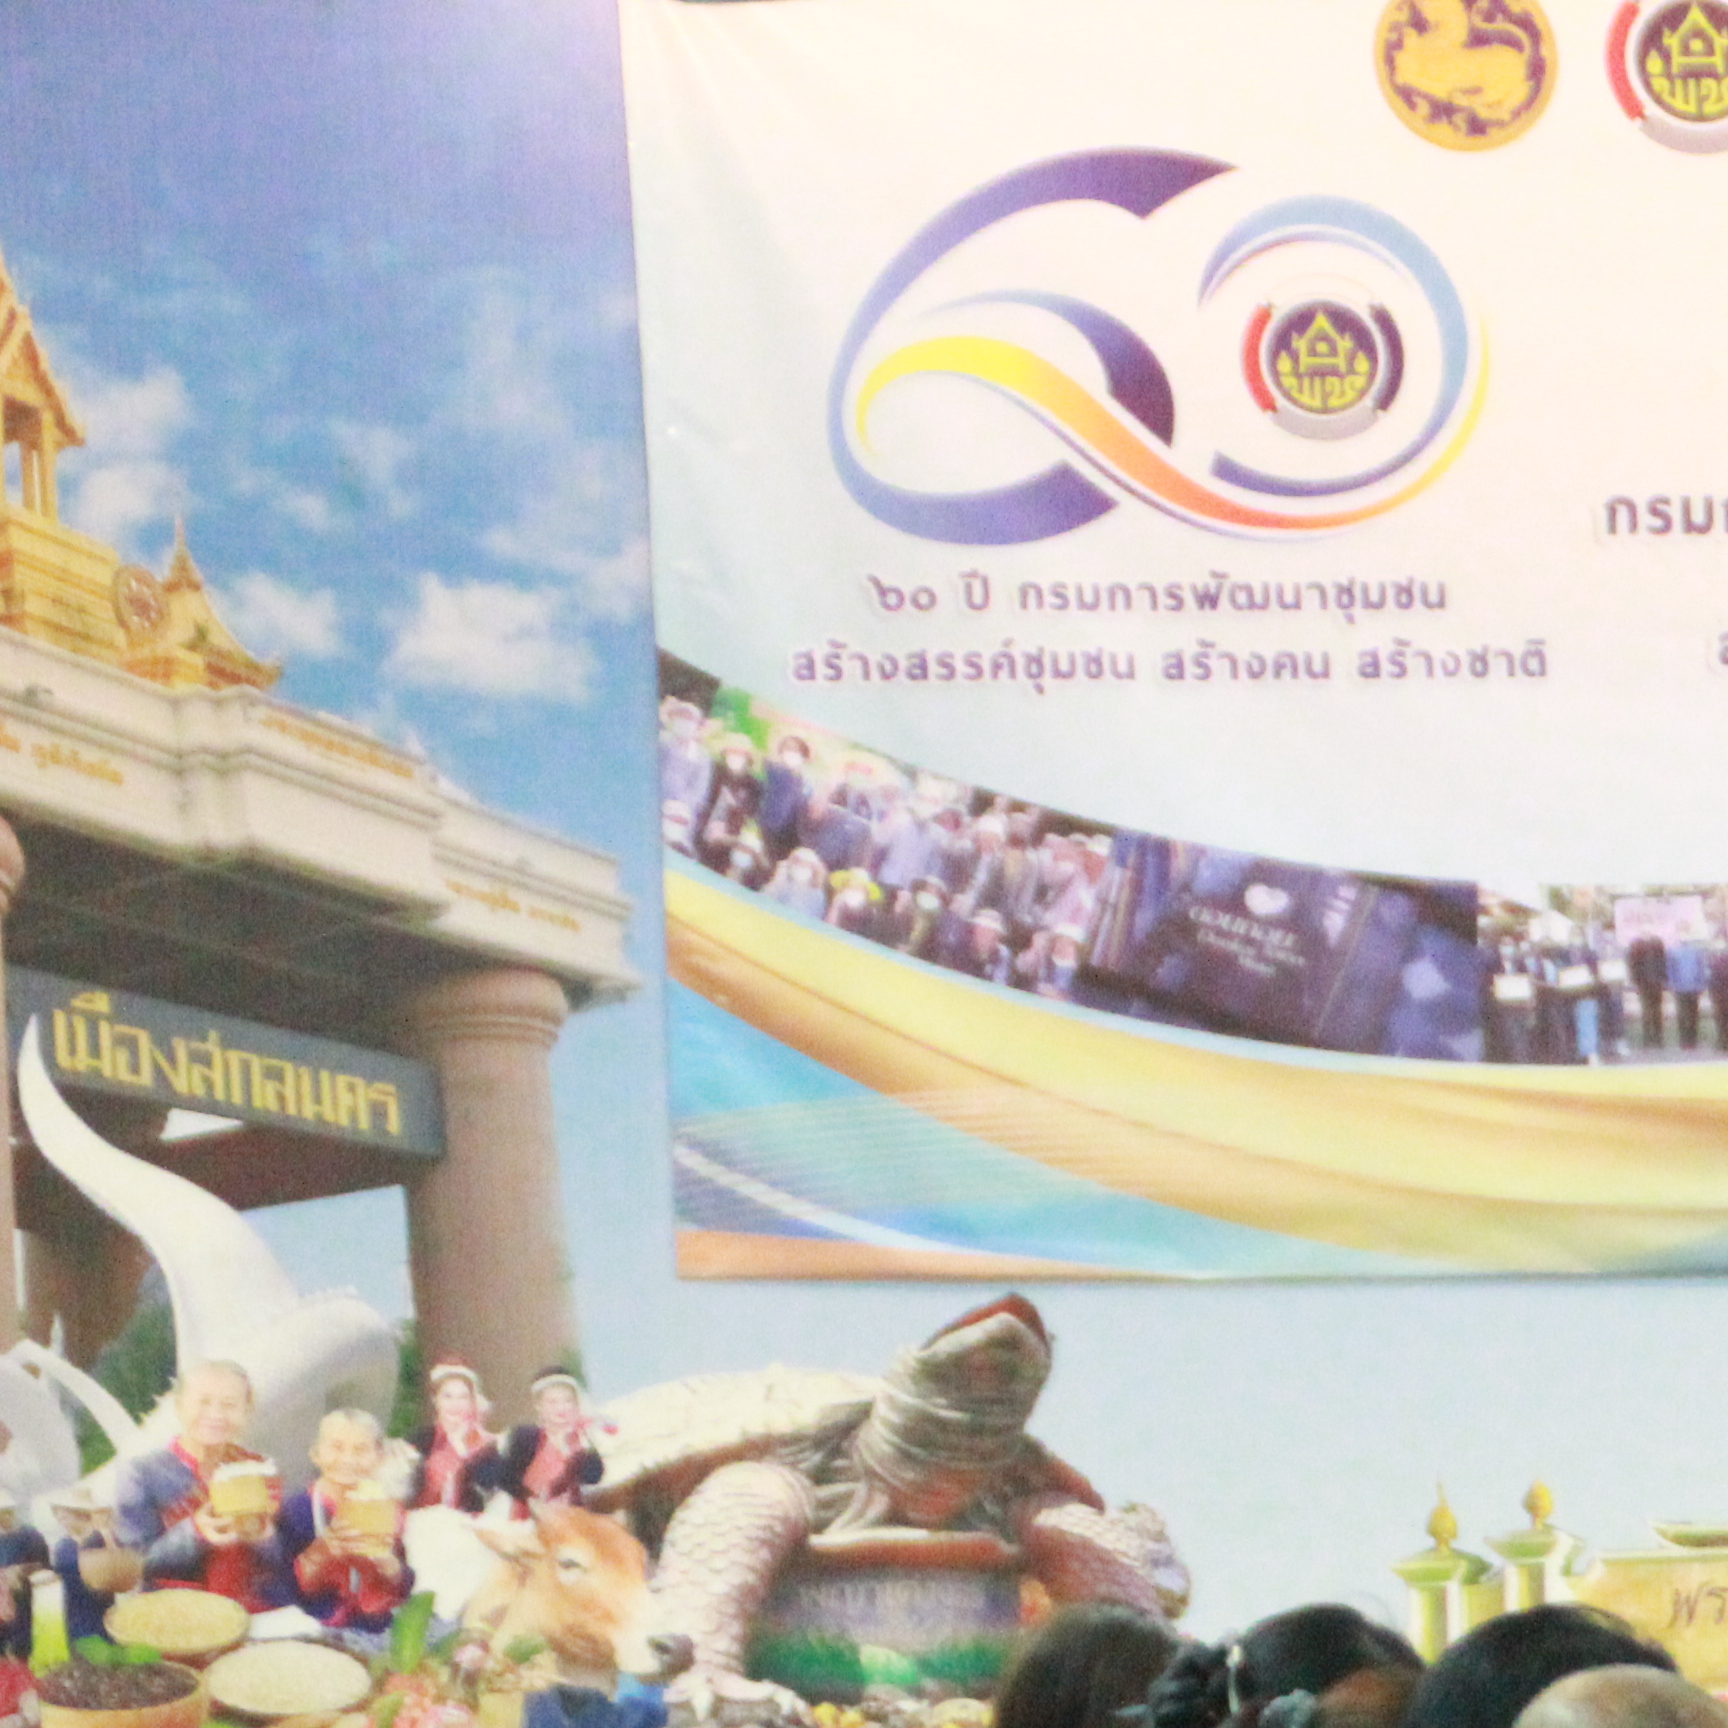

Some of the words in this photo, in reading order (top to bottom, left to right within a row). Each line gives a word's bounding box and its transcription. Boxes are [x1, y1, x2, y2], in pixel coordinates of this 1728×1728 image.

[868, 575, 938, 613] ๖๐
[961, 569, 992, 613] ปี
[1018, 570, 1448, 624] กรมการพัฒนาชุมชน
[793, 640, 1136, 695] สร้างสรรค์ชุมชน
[1162, 639, 1332, 682] สร้างคน
[1357, 636, 1548, 681] สร้างชาติ
[52, 990, 402, 1135] เมืองสกลนคร
